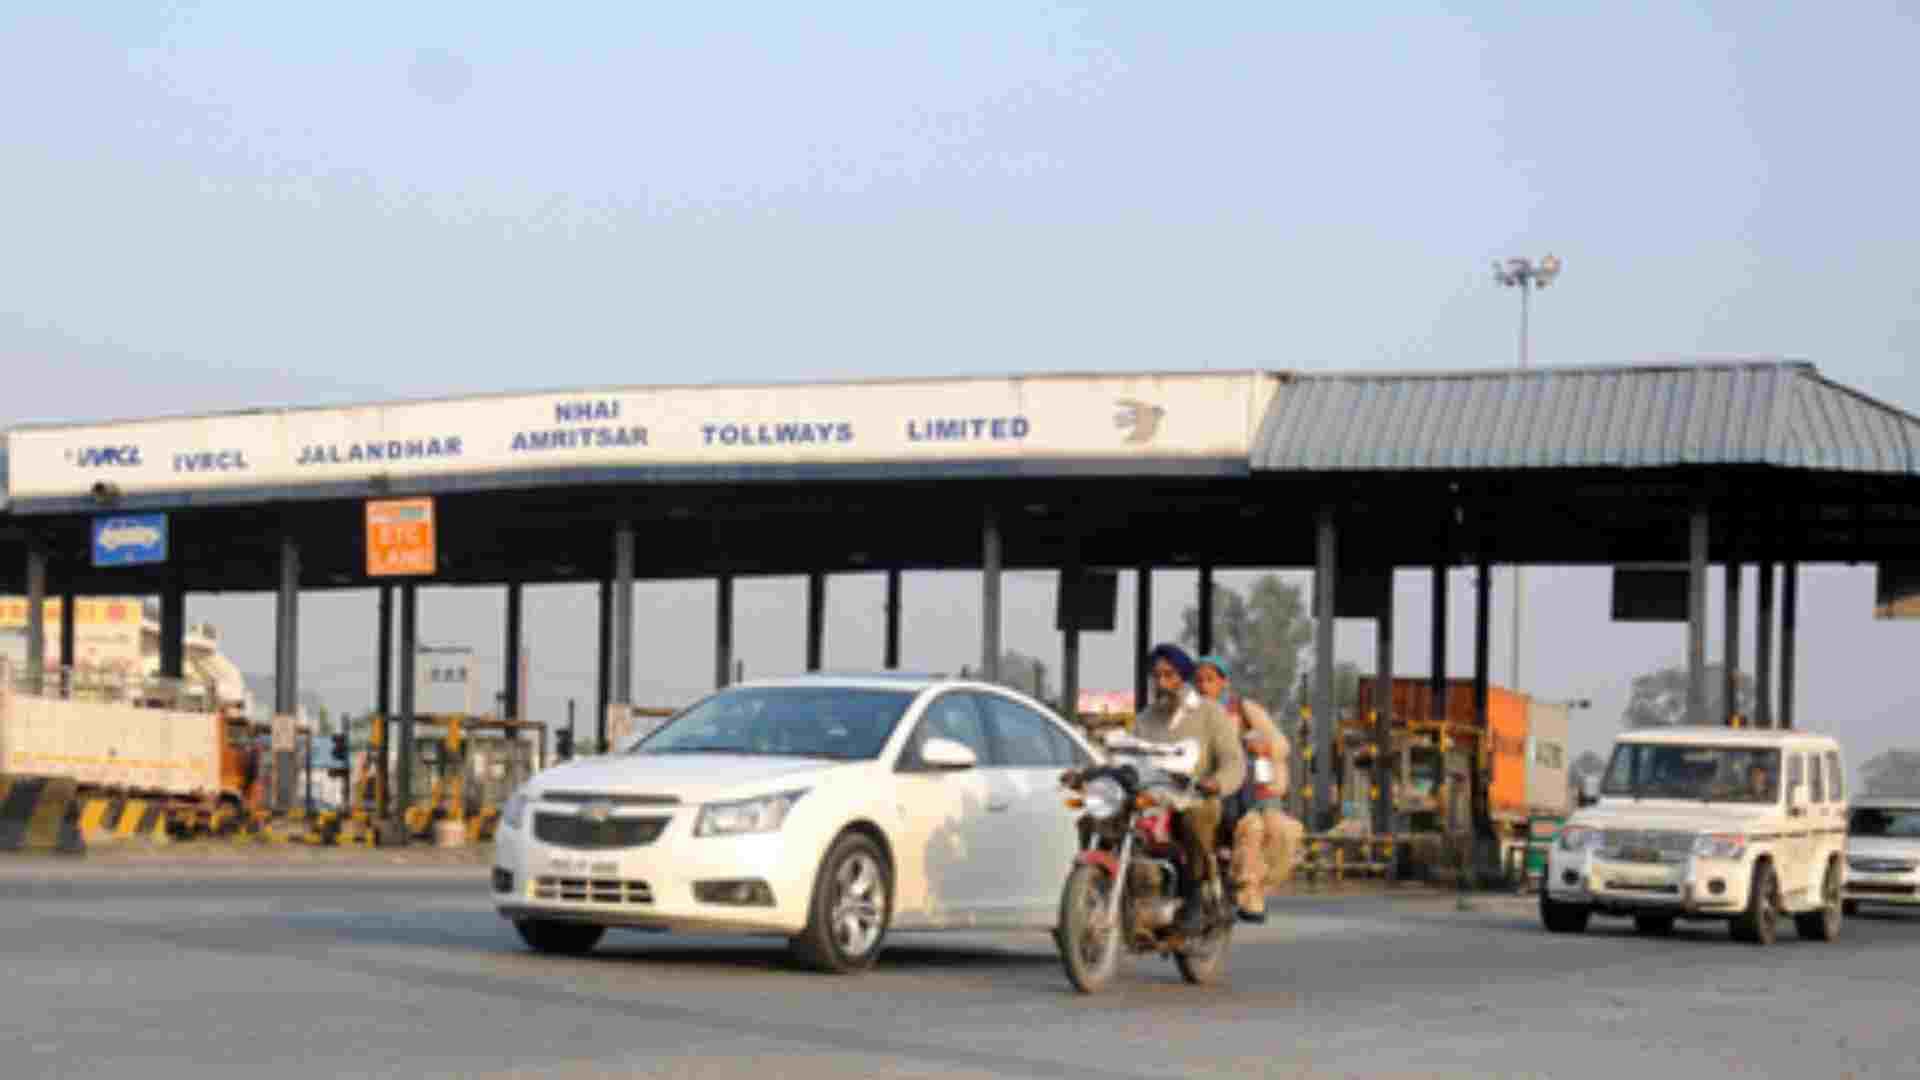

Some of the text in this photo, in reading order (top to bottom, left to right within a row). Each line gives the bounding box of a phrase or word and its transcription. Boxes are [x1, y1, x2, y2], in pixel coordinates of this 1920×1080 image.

[555, 399, 620, 422] NHAI
[173, 416, 1030, 471] IVRCL JALANDHAR AMRITSAR TOLLWAYS LIMITED
